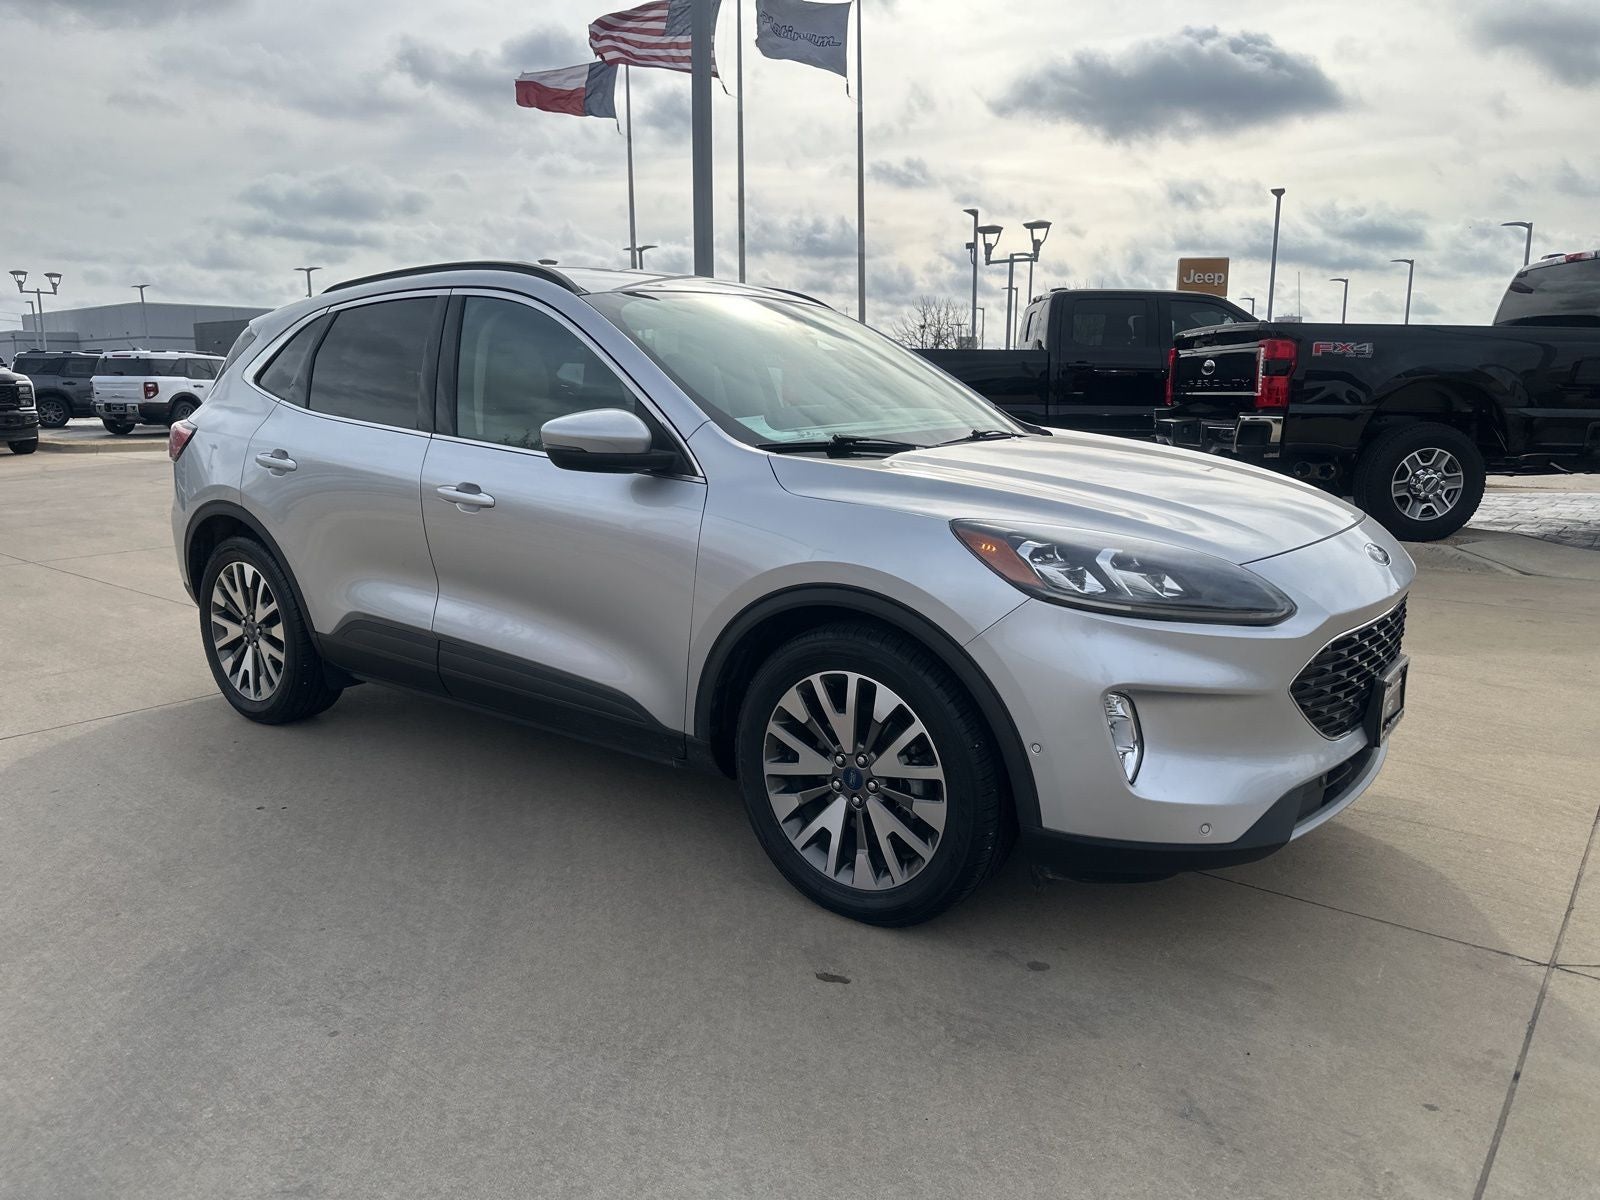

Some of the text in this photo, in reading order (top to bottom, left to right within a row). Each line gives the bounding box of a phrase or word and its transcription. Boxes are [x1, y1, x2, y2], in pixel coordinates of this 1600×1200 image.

[760, 10, 842, 47] Platinum
[1183, 269, 1225, 287] Jeep
[1312, 341, 1373, 357] FX4
